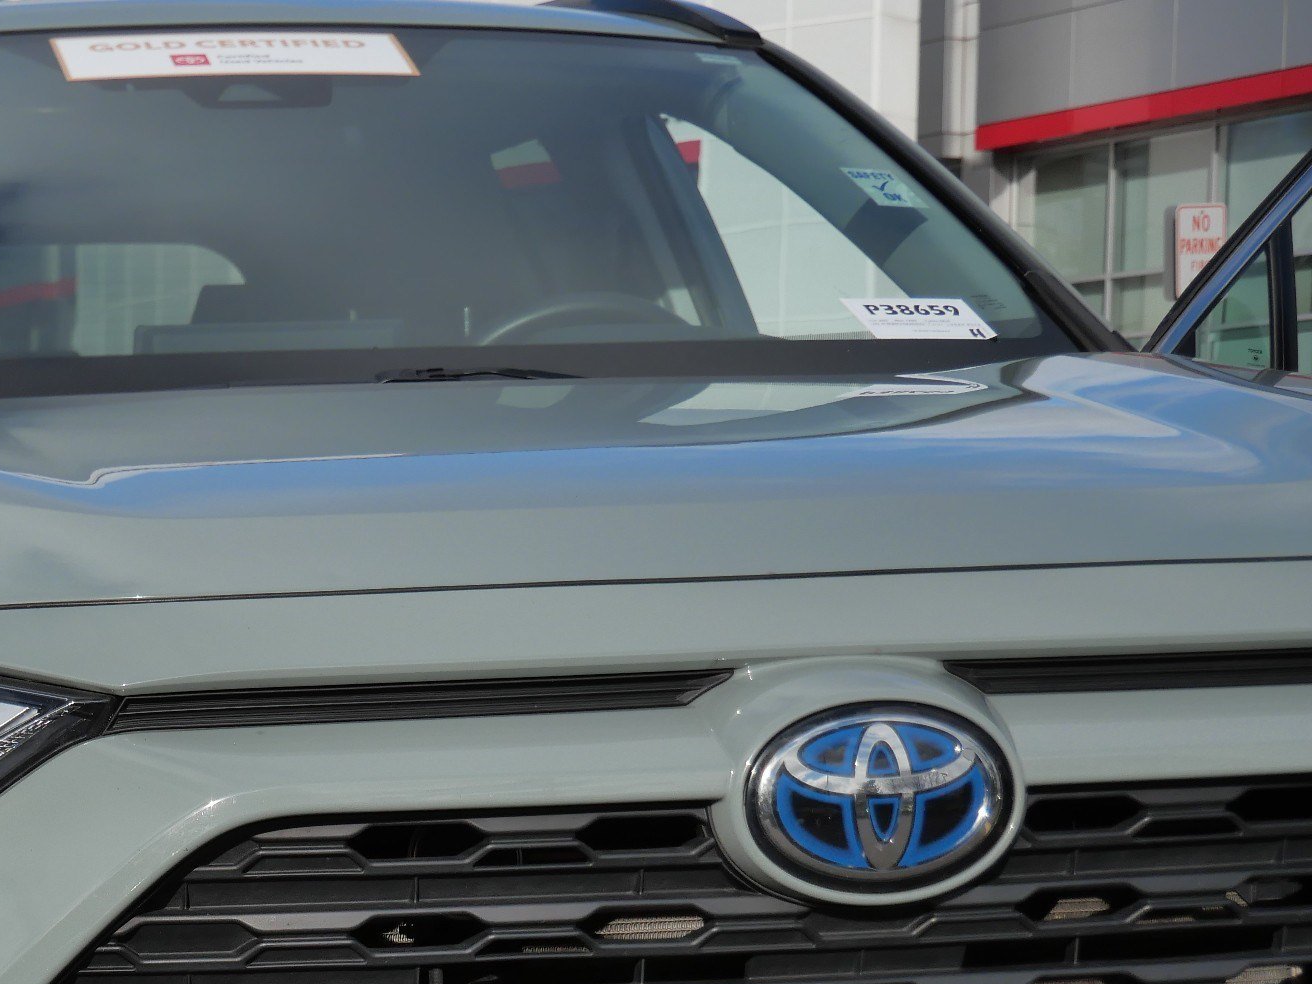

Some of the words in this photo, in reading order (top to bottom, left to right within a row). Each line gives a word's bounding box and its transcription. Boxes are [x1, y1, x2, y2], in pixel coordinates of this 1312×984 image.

[89, 40, 187, 52] GOLD
[194, 38, 366, 49] CERTIFIED
[847, 170, 895, 181] SAFETY
[1192, 214, 1211, 232] NO
[863, 304, 960, 317] P38659
